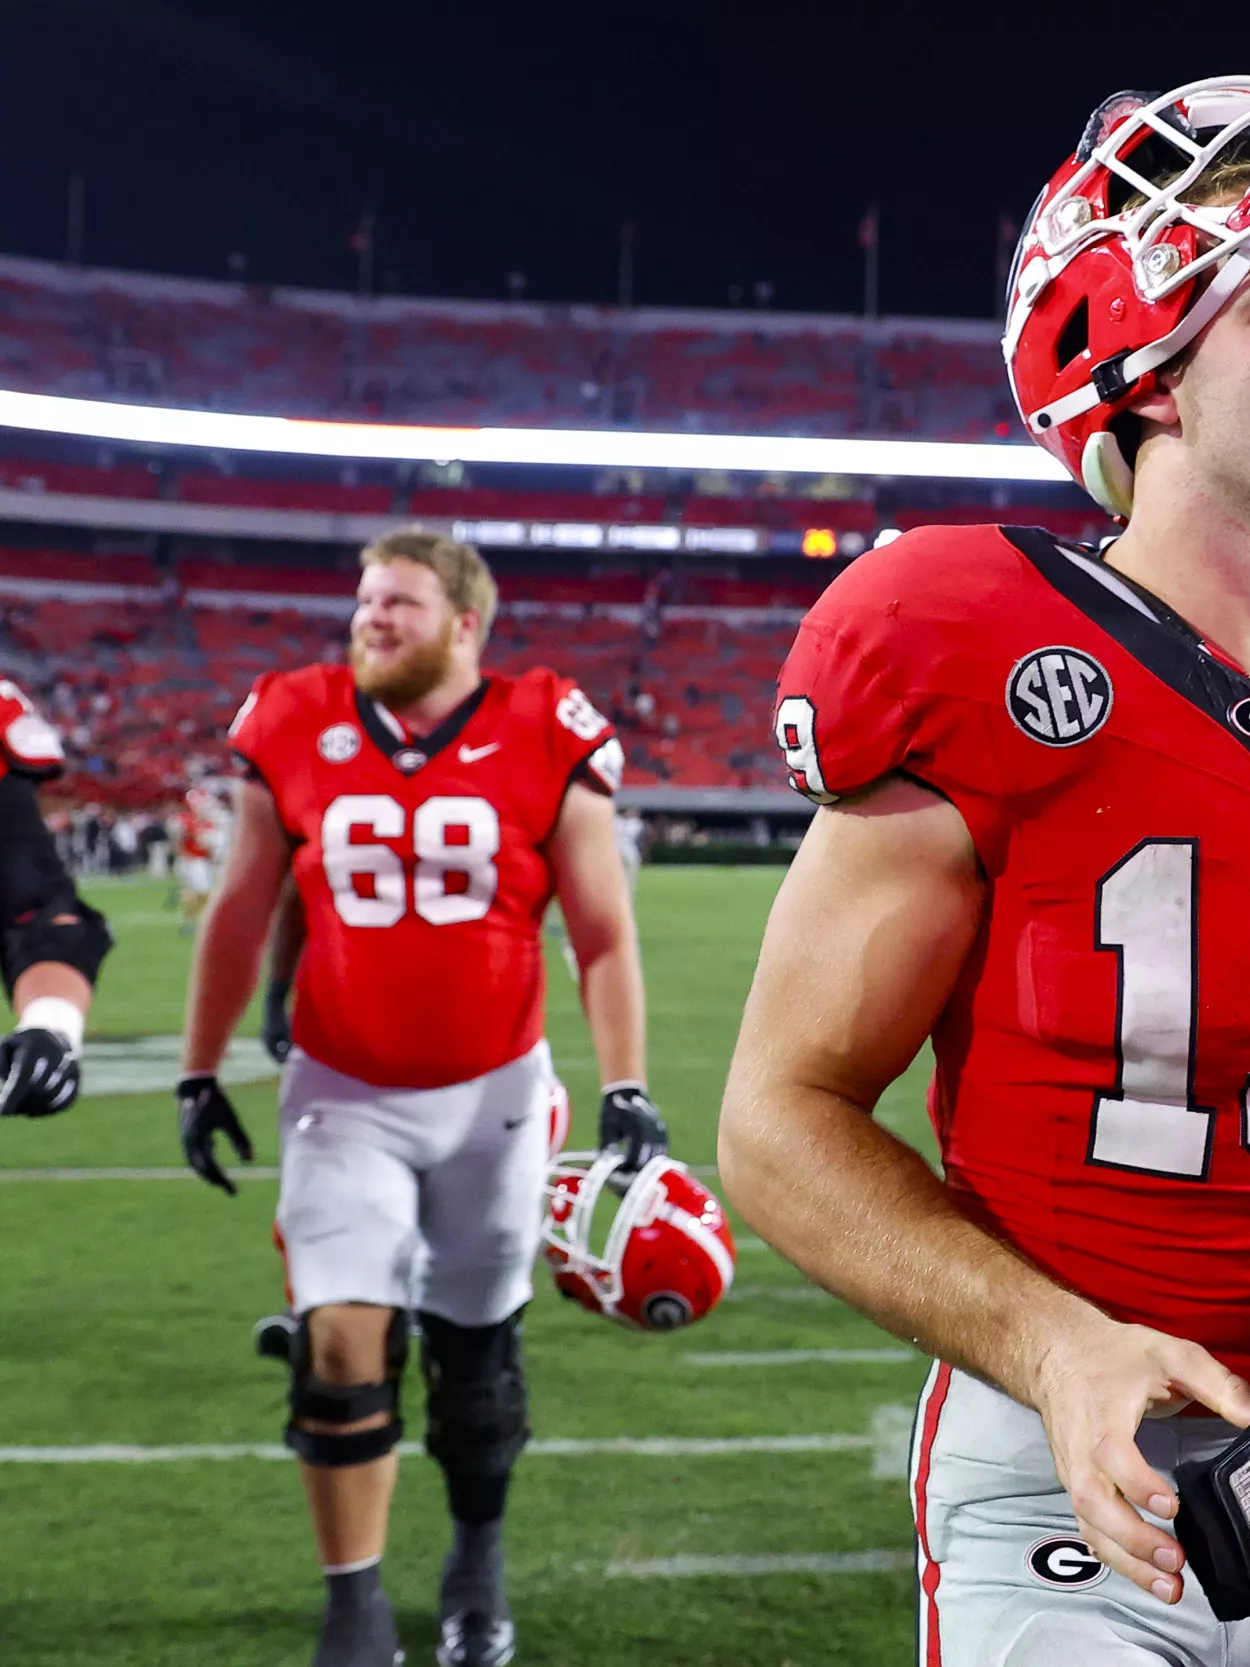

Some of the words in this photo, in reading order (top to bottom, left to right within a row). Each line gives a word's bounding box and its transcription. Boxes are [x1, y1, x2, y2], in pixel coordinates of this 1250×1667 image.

[1015, 653, 1104, 739] SEC
[775, 695, 839, 805] 9
[321, 794, 500, 928] 68
[1029, 1538, 1103, 1585] G
